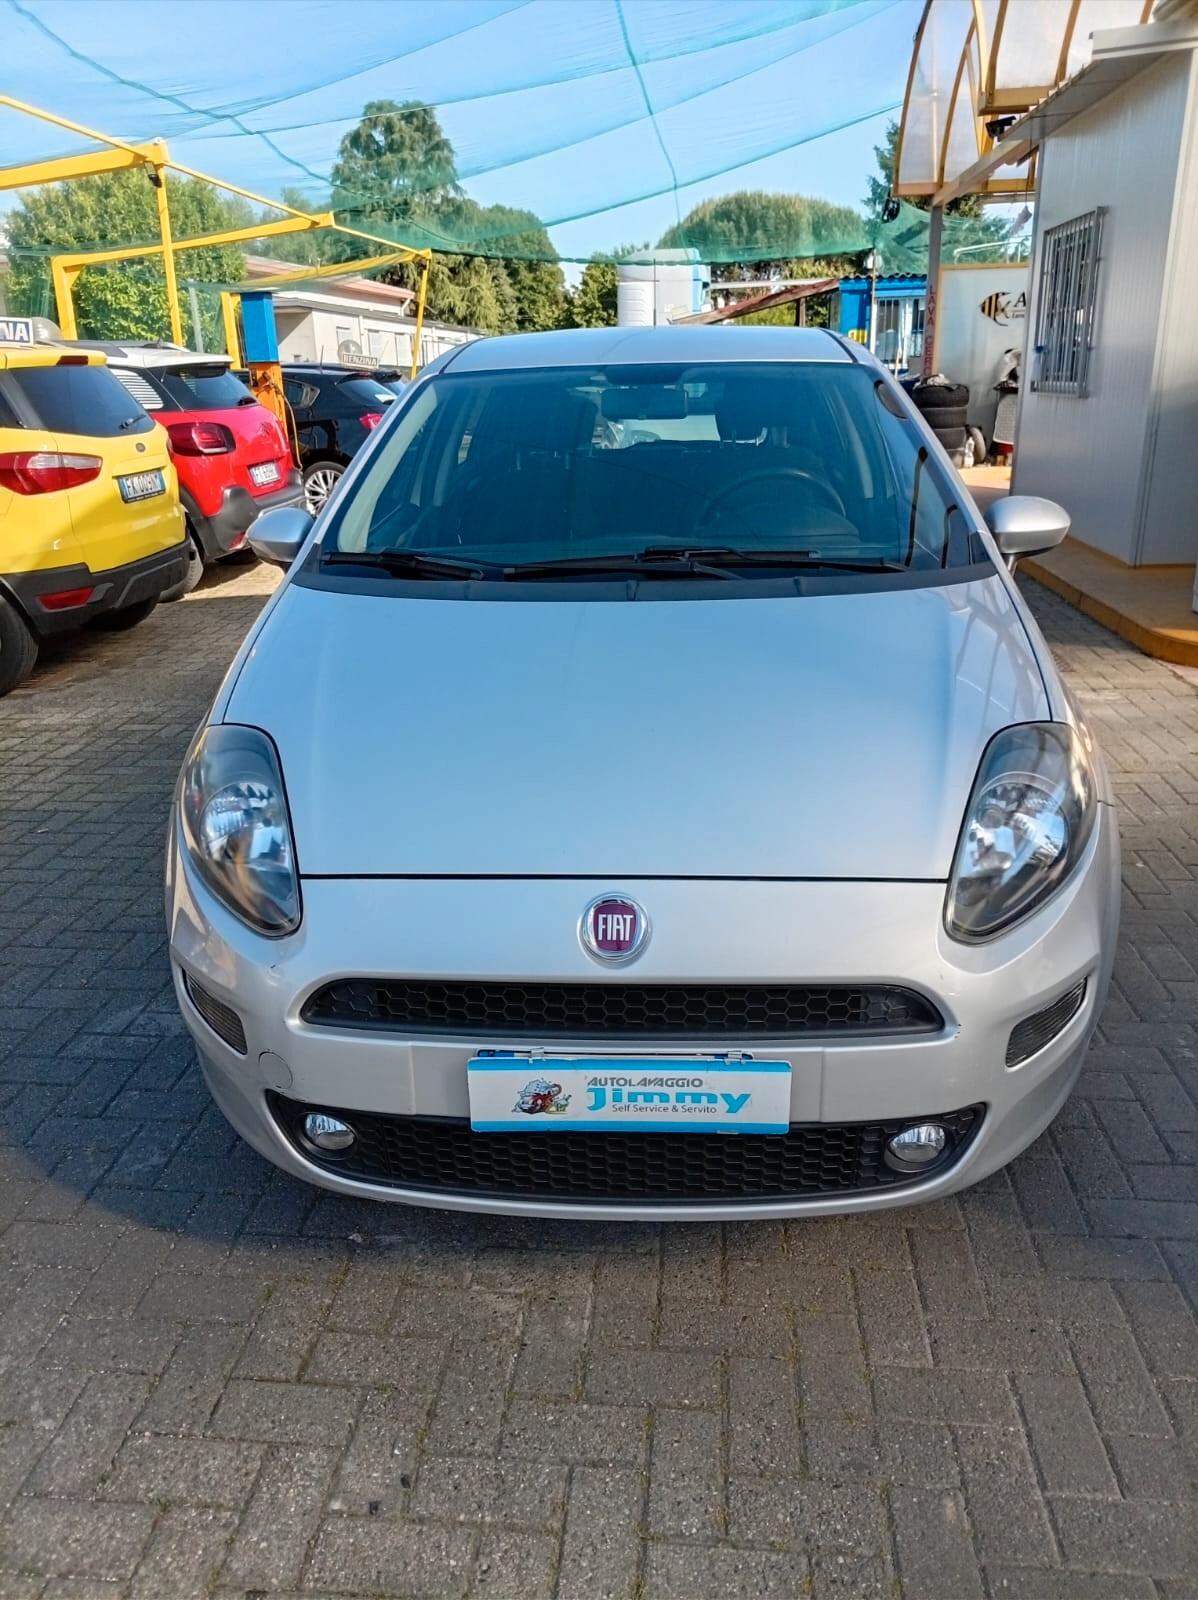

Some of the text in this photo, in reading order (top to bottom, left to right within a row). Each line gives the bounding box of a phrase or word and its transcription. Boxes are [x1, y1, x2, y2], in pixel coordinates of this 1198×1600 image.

[927, 285, 936, 326] LAVA
[343, 354, 378, 366] BENZINA
[598, 913, 634, 941] FIAT
[587, 1077, 703, 1088] AUTOLAVAGGIO
[612, 1104, 717, 1114] Self Service & Servito
